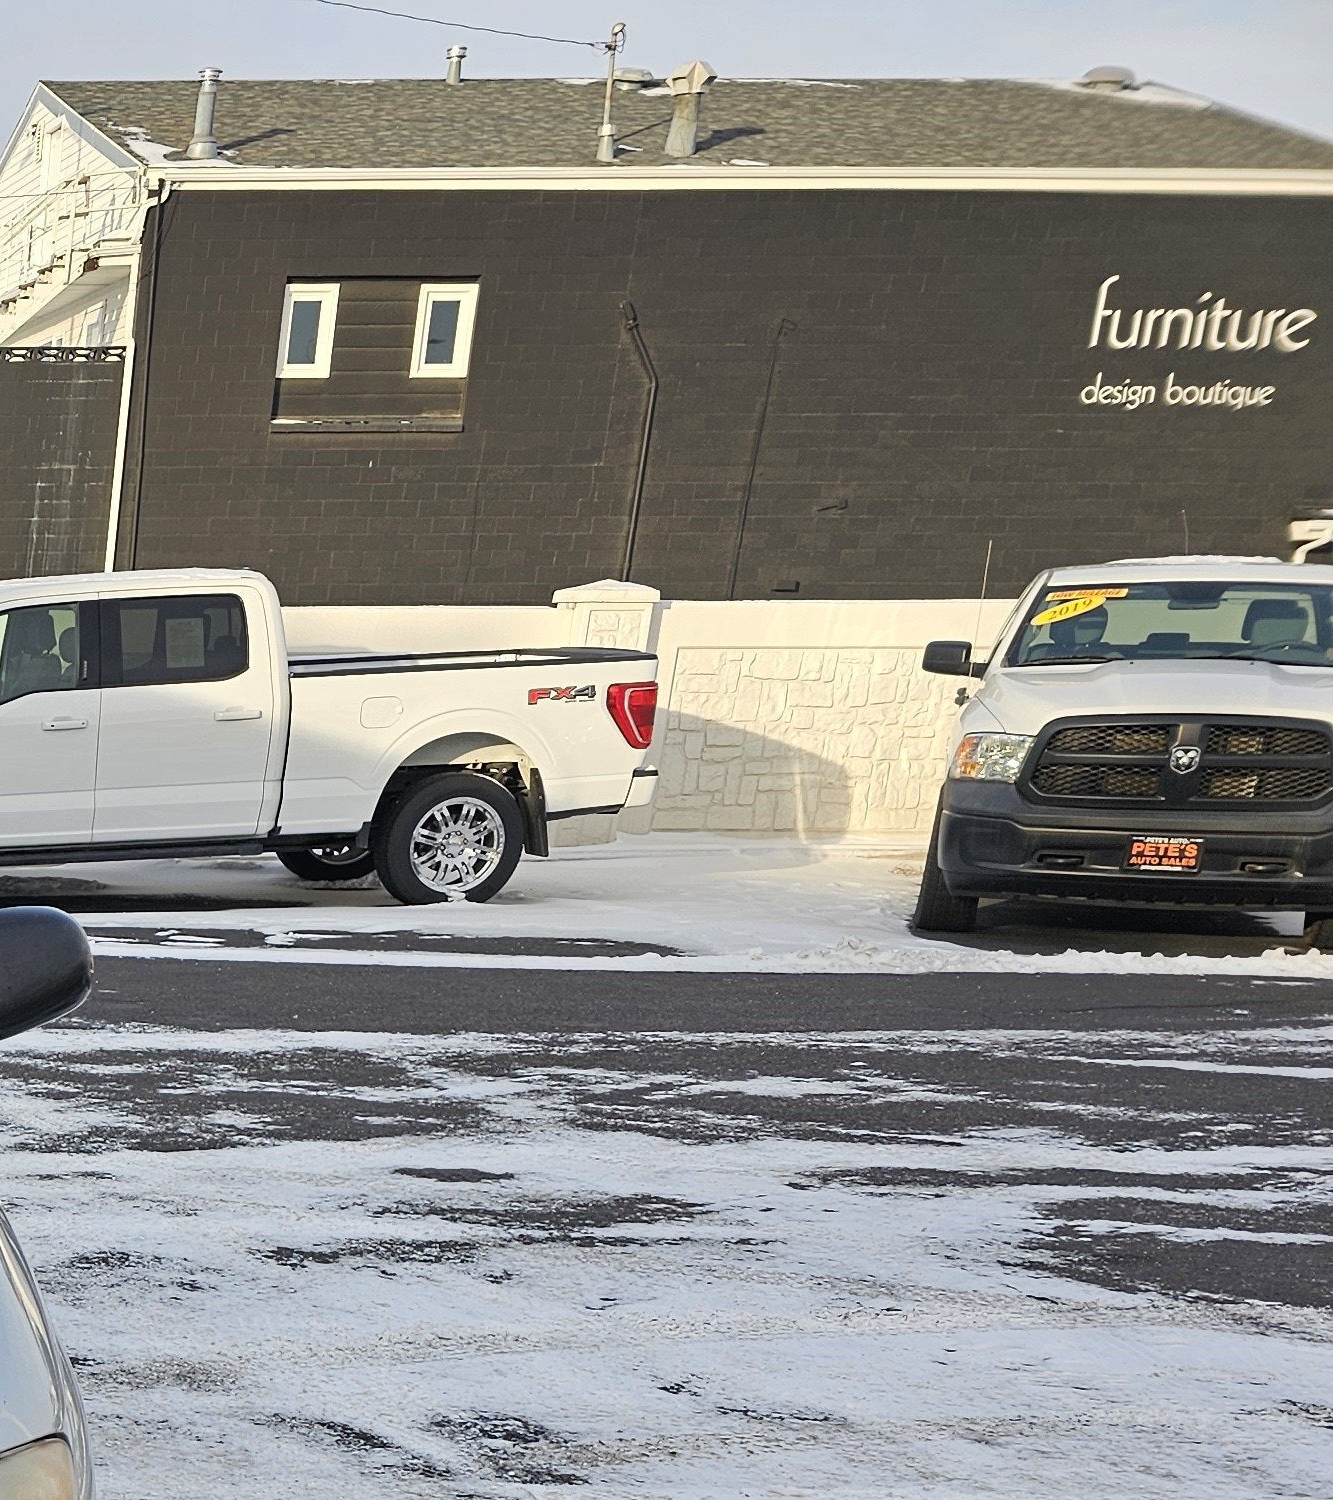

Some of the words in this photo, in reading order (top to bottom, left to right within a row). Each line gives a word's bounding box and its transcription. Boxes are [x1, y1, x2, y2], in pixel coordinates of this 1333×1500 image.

[1088, 274, 1318, 352] furniture
[1080, 371, 1156, 410] design
[1163, 371, 1276, 411] boutique
[1047, 598, 1093, 620] 2019
[527, 684, 597, 705] FX4
[1131, 842, 1199, 857] PETE'S
[1129, 856, 1160, 864] AUTO
[1161, 858, 1197, 866] SALES
